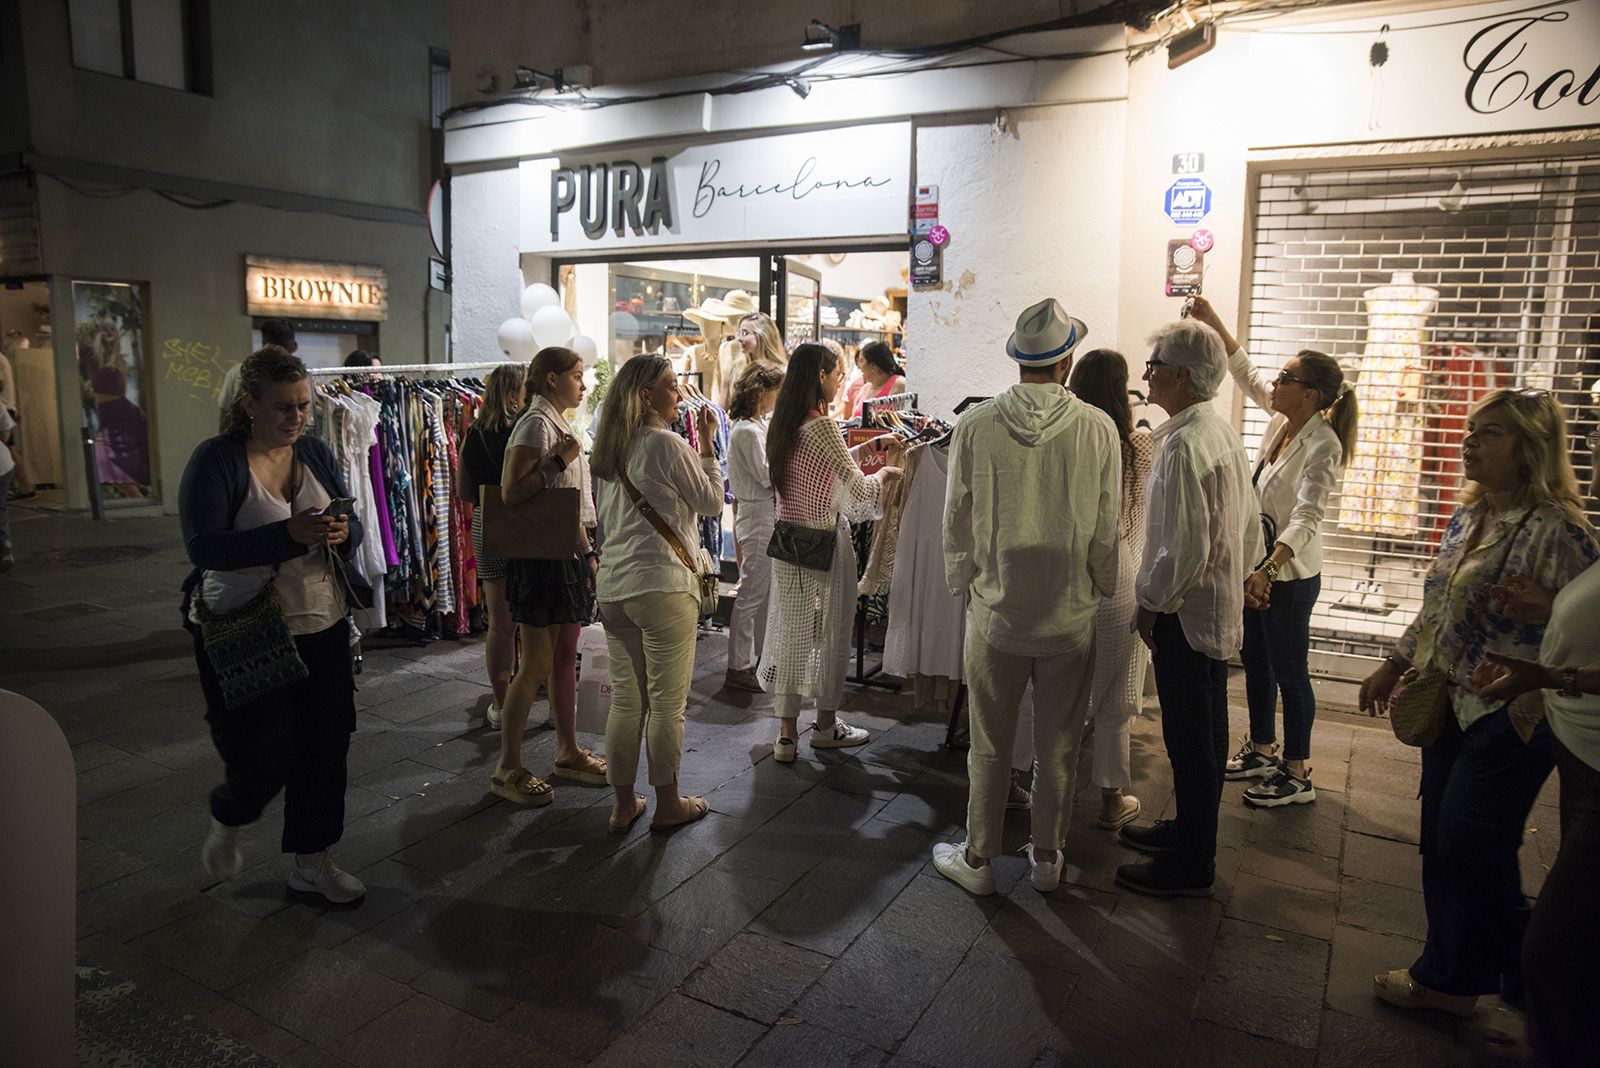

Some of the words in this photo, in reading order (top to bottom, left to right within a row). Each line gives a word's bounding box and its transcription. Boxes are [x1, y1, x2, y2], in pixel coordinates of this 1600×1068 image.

[1177, 153, 1200, 173] 30
[550, 157, 674, 240] PURA
[693, 156, 892, 218] Barcelona
[1172, 190, 1203, 208] ADT
[261, 276, 381, 305] BROWNIE
